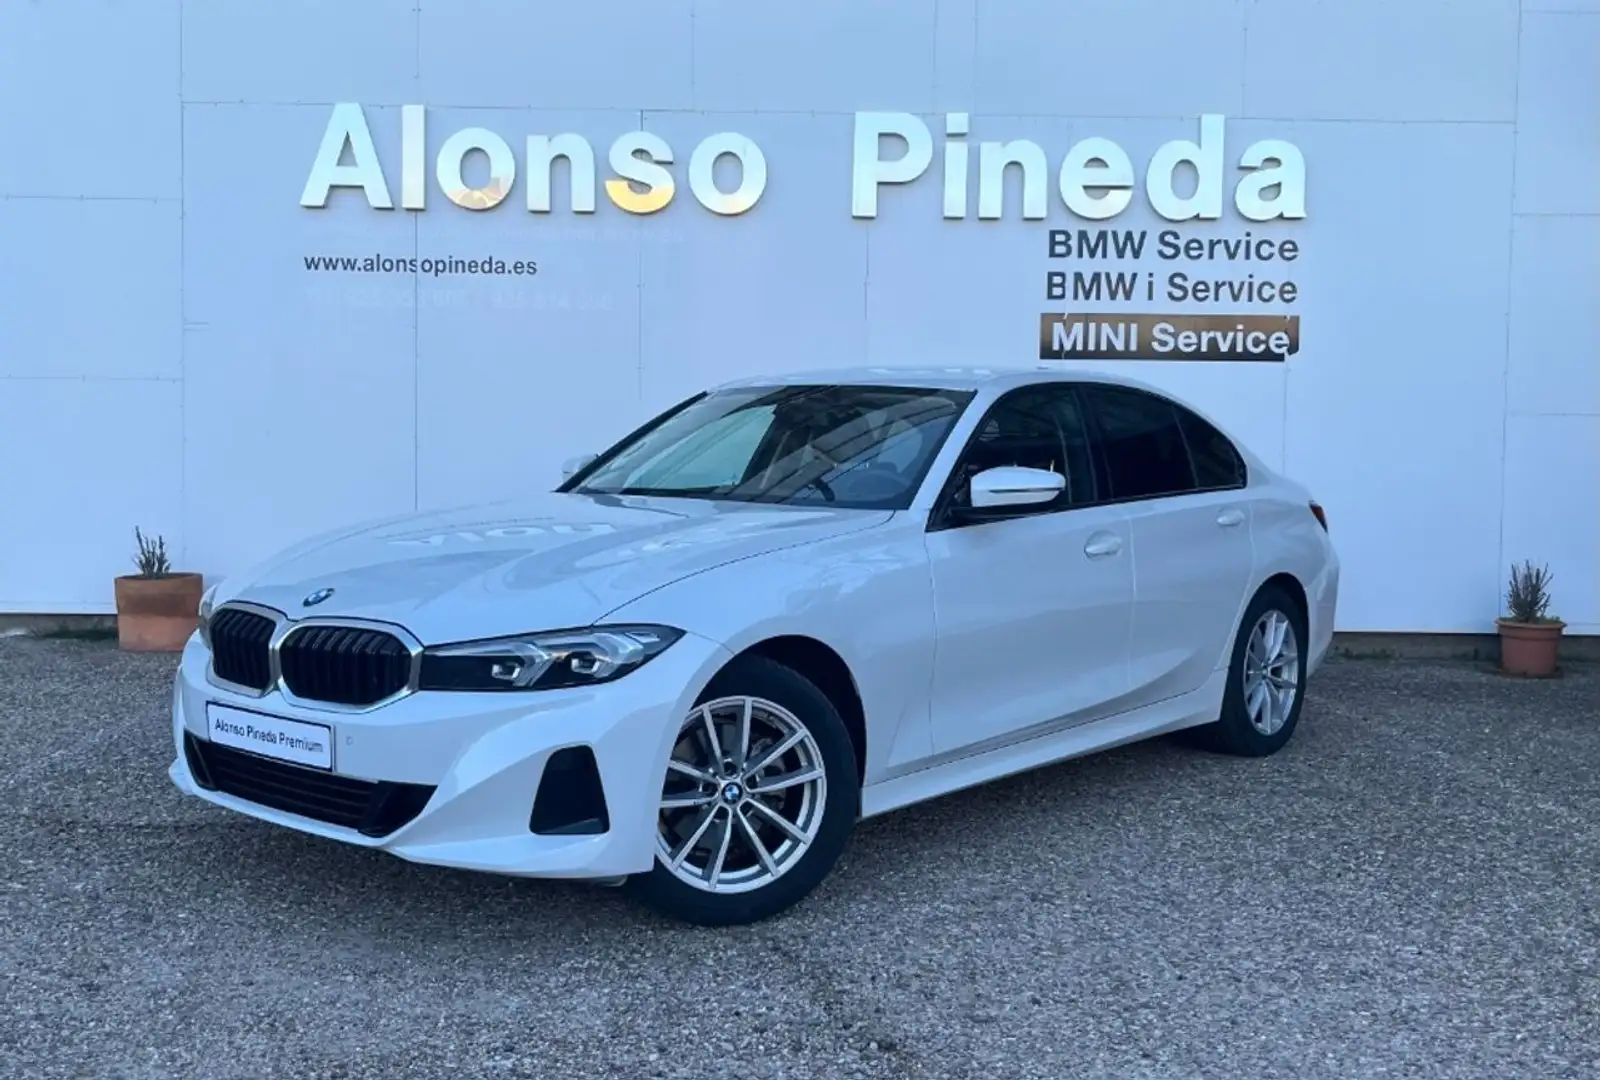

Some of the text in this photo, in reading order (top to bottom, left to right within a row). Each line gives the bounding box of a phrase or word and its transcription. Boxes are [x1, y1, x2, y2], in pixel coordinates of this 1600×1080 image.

[300, 102, 1307, 221] Alonso Pineda
[1048, 230, 1299, 261] BMW Service
[303, 253, 538, 277] www.alonsopineda.es
[1046, 271, 1298, 303] BMW i Service
[1051, 322, 1290, 354] MINI Service
[215, 718, 323, 752] Alonso Pineda Premium
